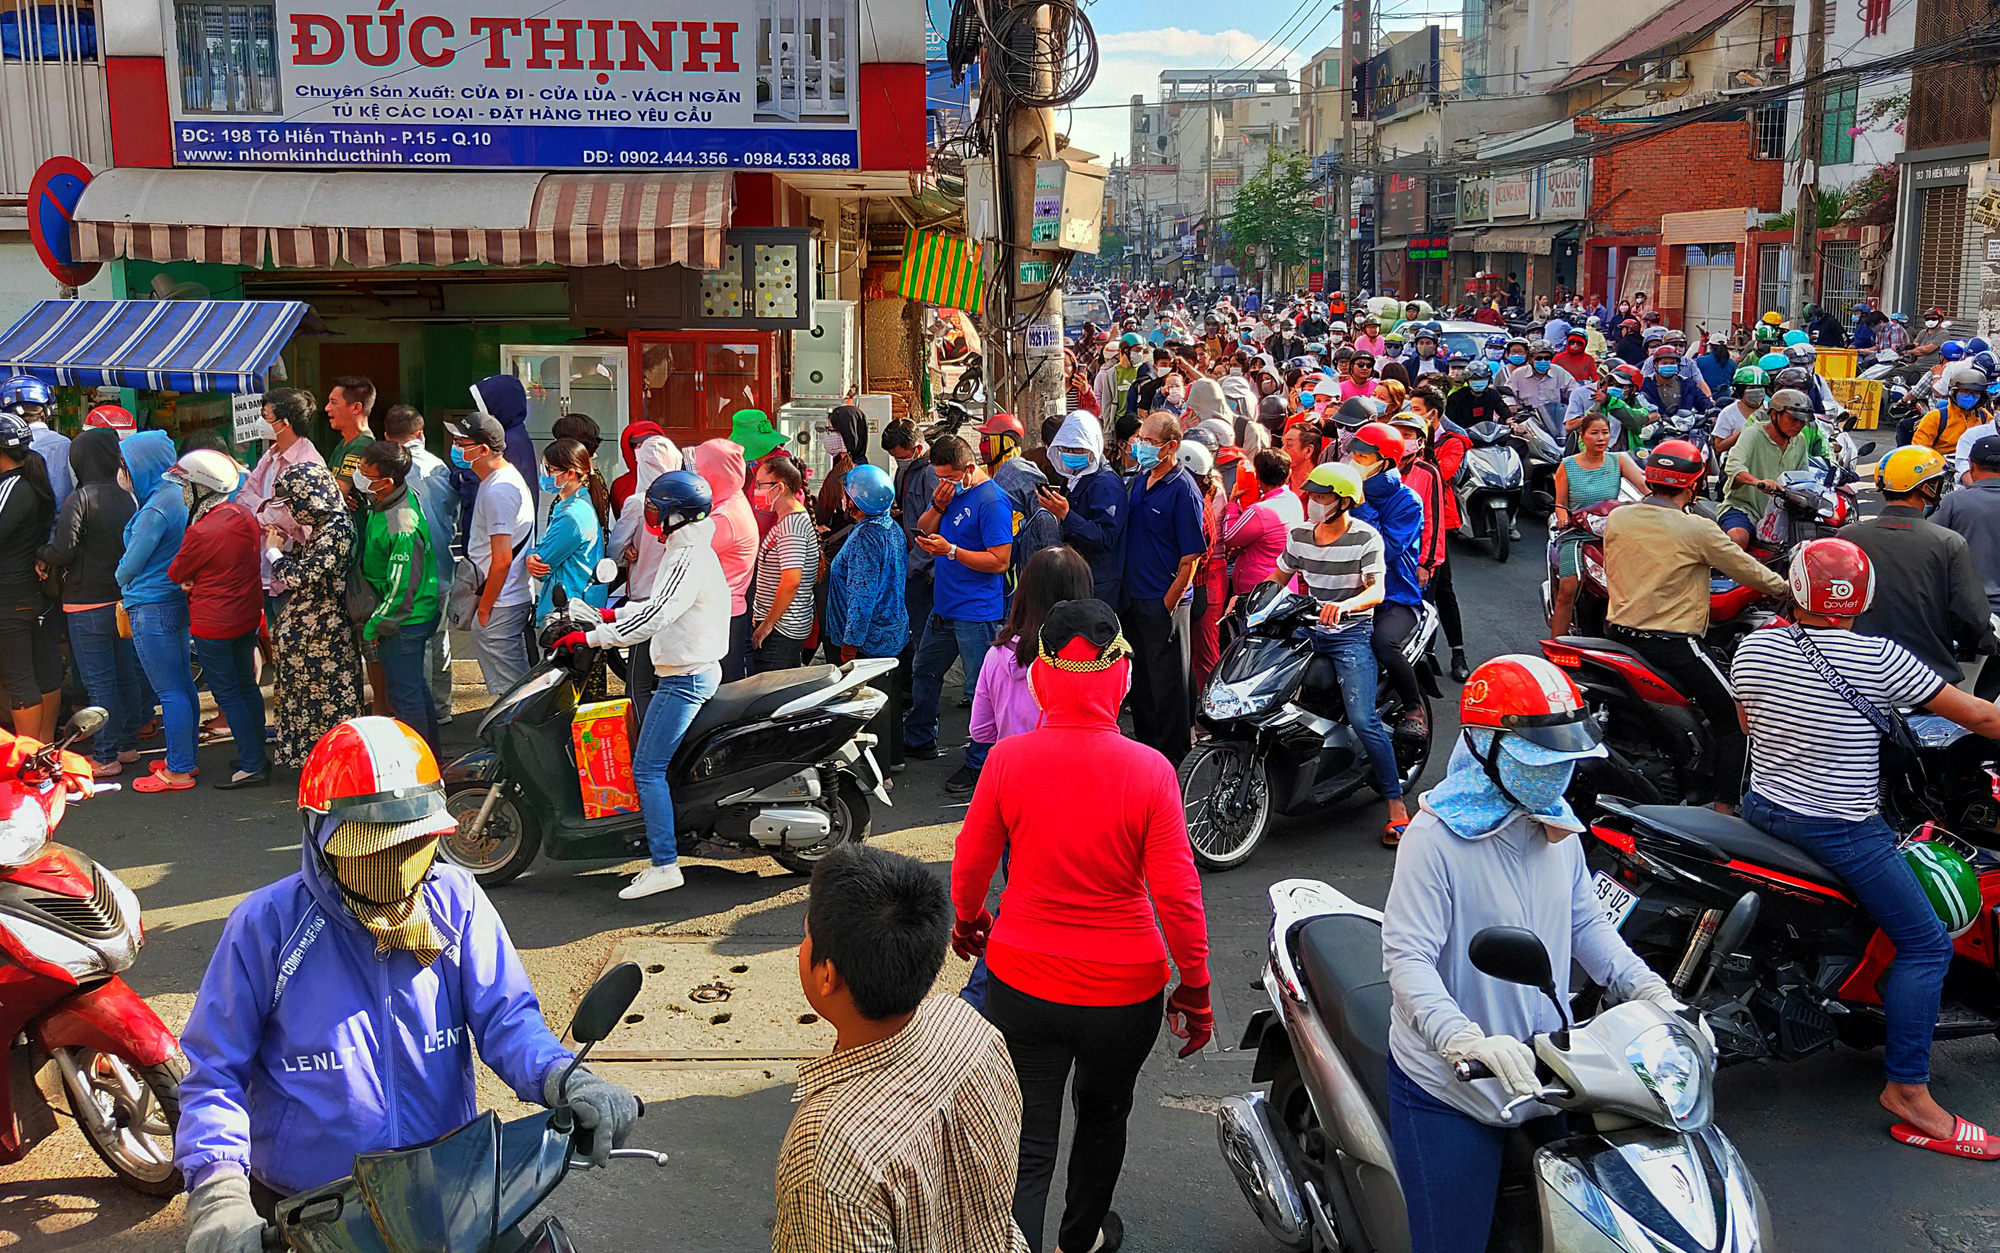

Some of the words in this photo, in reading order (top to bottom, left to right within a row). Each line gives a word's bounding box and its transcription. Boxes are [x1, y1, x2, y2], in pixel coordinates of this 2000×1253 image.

[289, 0, 457, 68] ĐỨC
[470, 17, 741, 86] THỊNH
[295, 85, 364, 99] Chuyên
[370, 84, 402, 98] Sản
[408, 84, 455, 100] Xuất:
[460, 84, 499, 101] CỬA
[505, 88, 525, 100] ĐI
[539, 85, 578, 101] CỬA
[583, 86, 616, 102] LÙA
[631, 87, 683, 103] VÁCH
[689, 87, 741, 104] NGĂN
[332, 101, 354, 118] TỦ
[359, 104, 380, 121] KỆ
[385, 104, 426, 120] CÁC
[432, 106, 474, 123] LOẠI
[489, 104, 524, 124] ĐẶT
[529, 105, 583, 121] HÀNG
[588, 108, 632, 122] THEO
[637, 107, 669, 122] YÊU
[675, 104, 713, 124] CẦU
[181, 129, 216, 144] ĐC:
[221, 129, 252, 144] 198
[257, 129, 280, 144] Tô
[285, 126, 325, 144] Hiến
[330, 129, 386, 146] Thành
[402, 131, 436, 146] P.15
[452, 131, 491, 147] Q.10
[183, 150, 233, 162] www:
[239, 148, 402, 163] nhomkinhducthinh
[409, 150, 451, 164] .com
[583, 150, 613, 164] DĐ:
[619, 150, 728, 166] 0902.444.356
[743, 151, 851, 167] 0984.533.868
[1547, 171, 1581, 192] QUANG
[1552, 191, 1576, 208] ANH
[1955, 1144, 1984, 1155] KOLA
